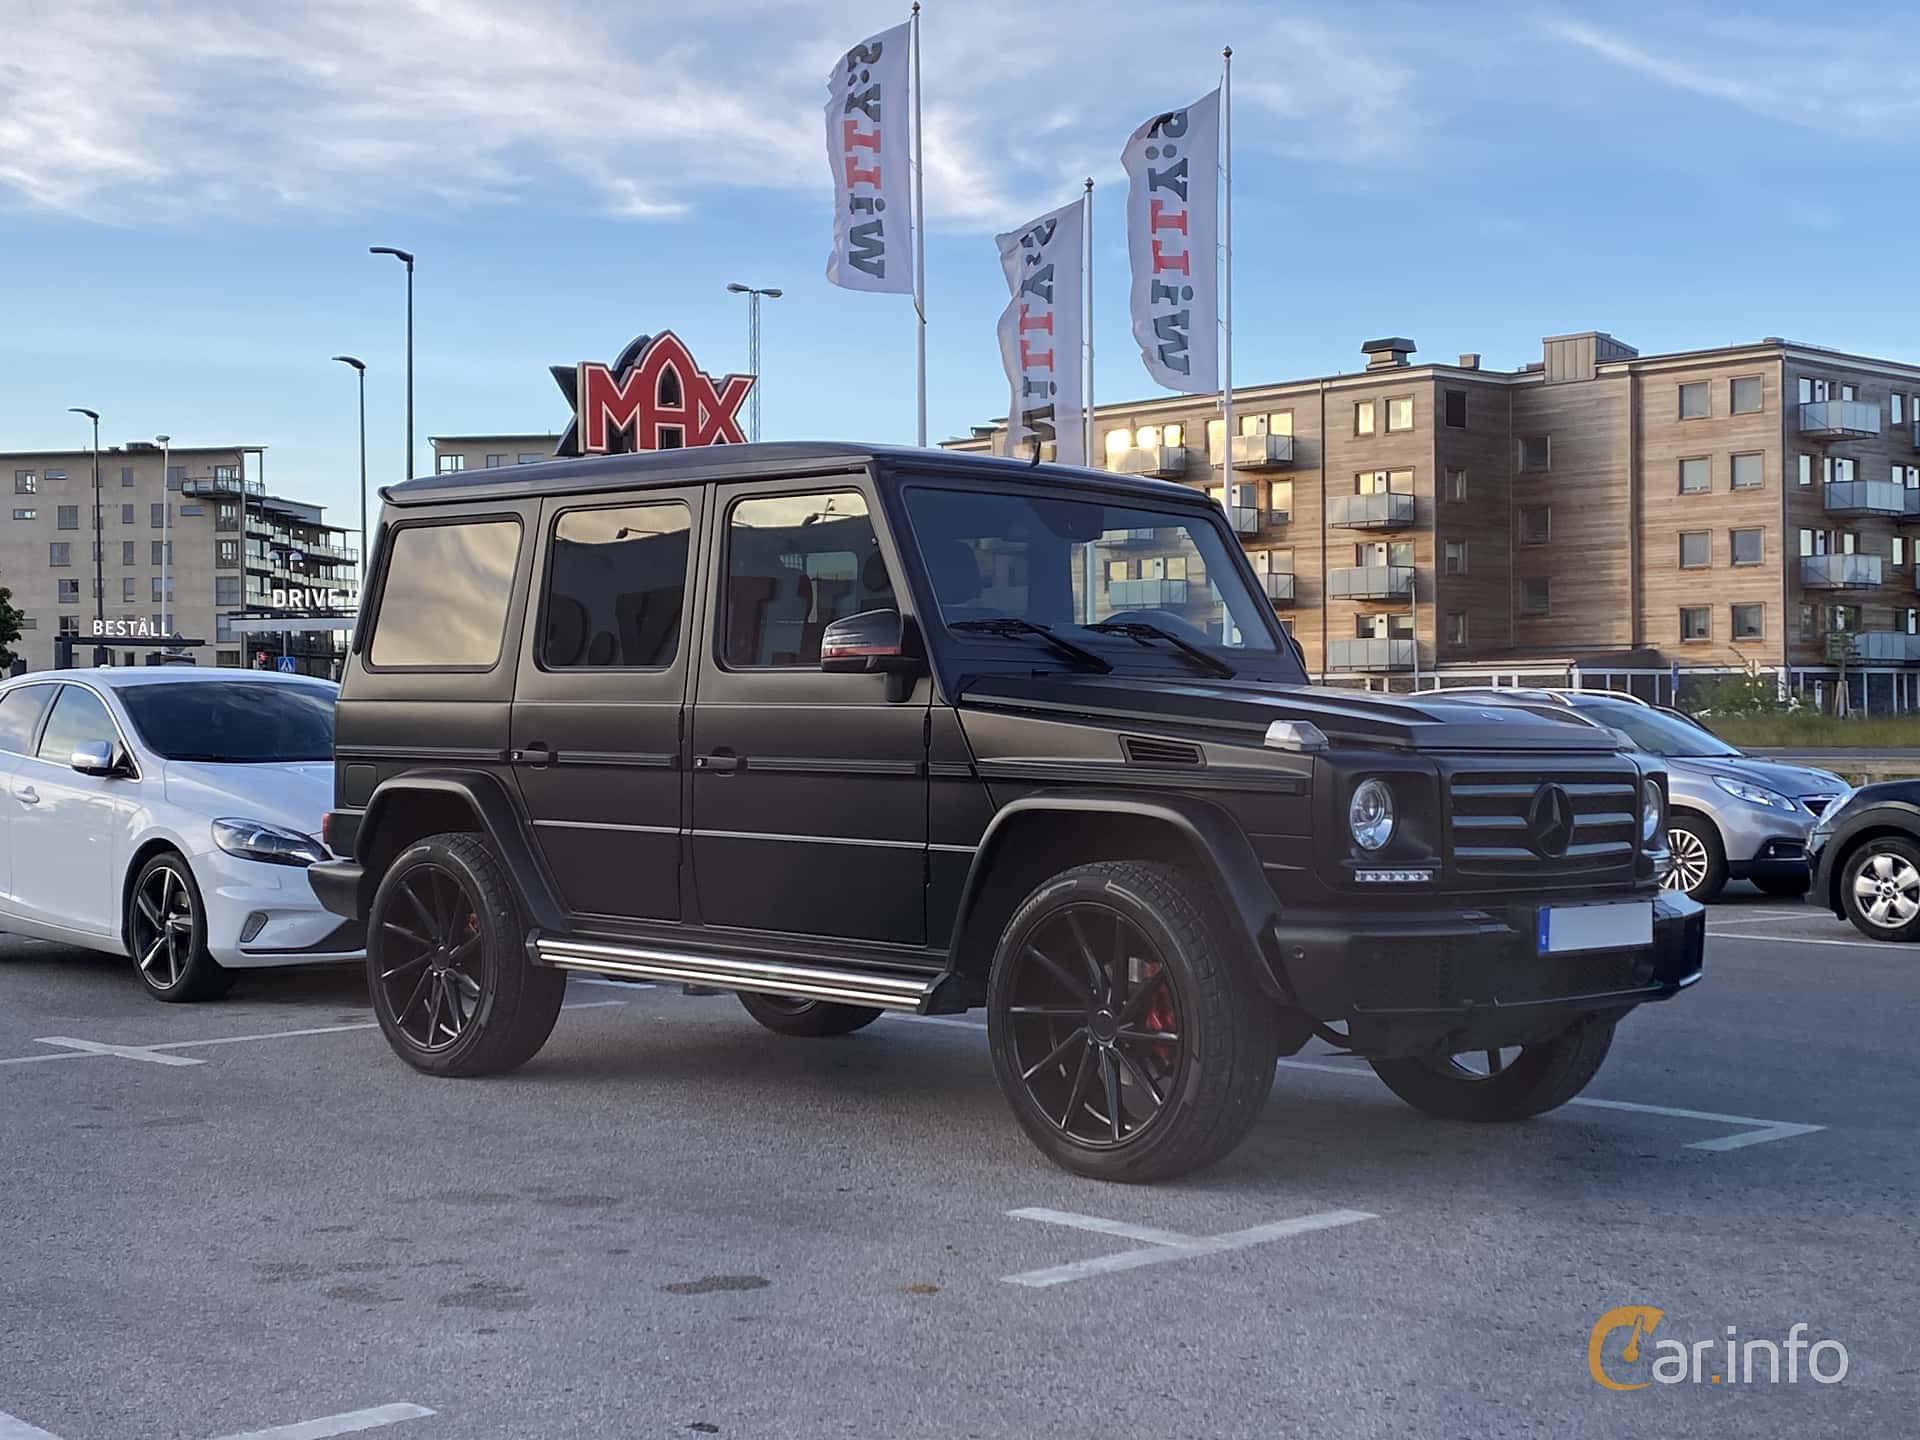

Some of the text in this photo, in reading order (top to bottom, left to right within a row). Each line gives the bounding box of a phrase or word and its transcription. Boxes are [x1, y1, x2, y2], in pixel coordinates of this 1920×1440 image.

[577, 330, 757, 453] MAX
[272, 588, 339, 607] DRIVE
[93, 617, 170, 637] BESTÄLL
